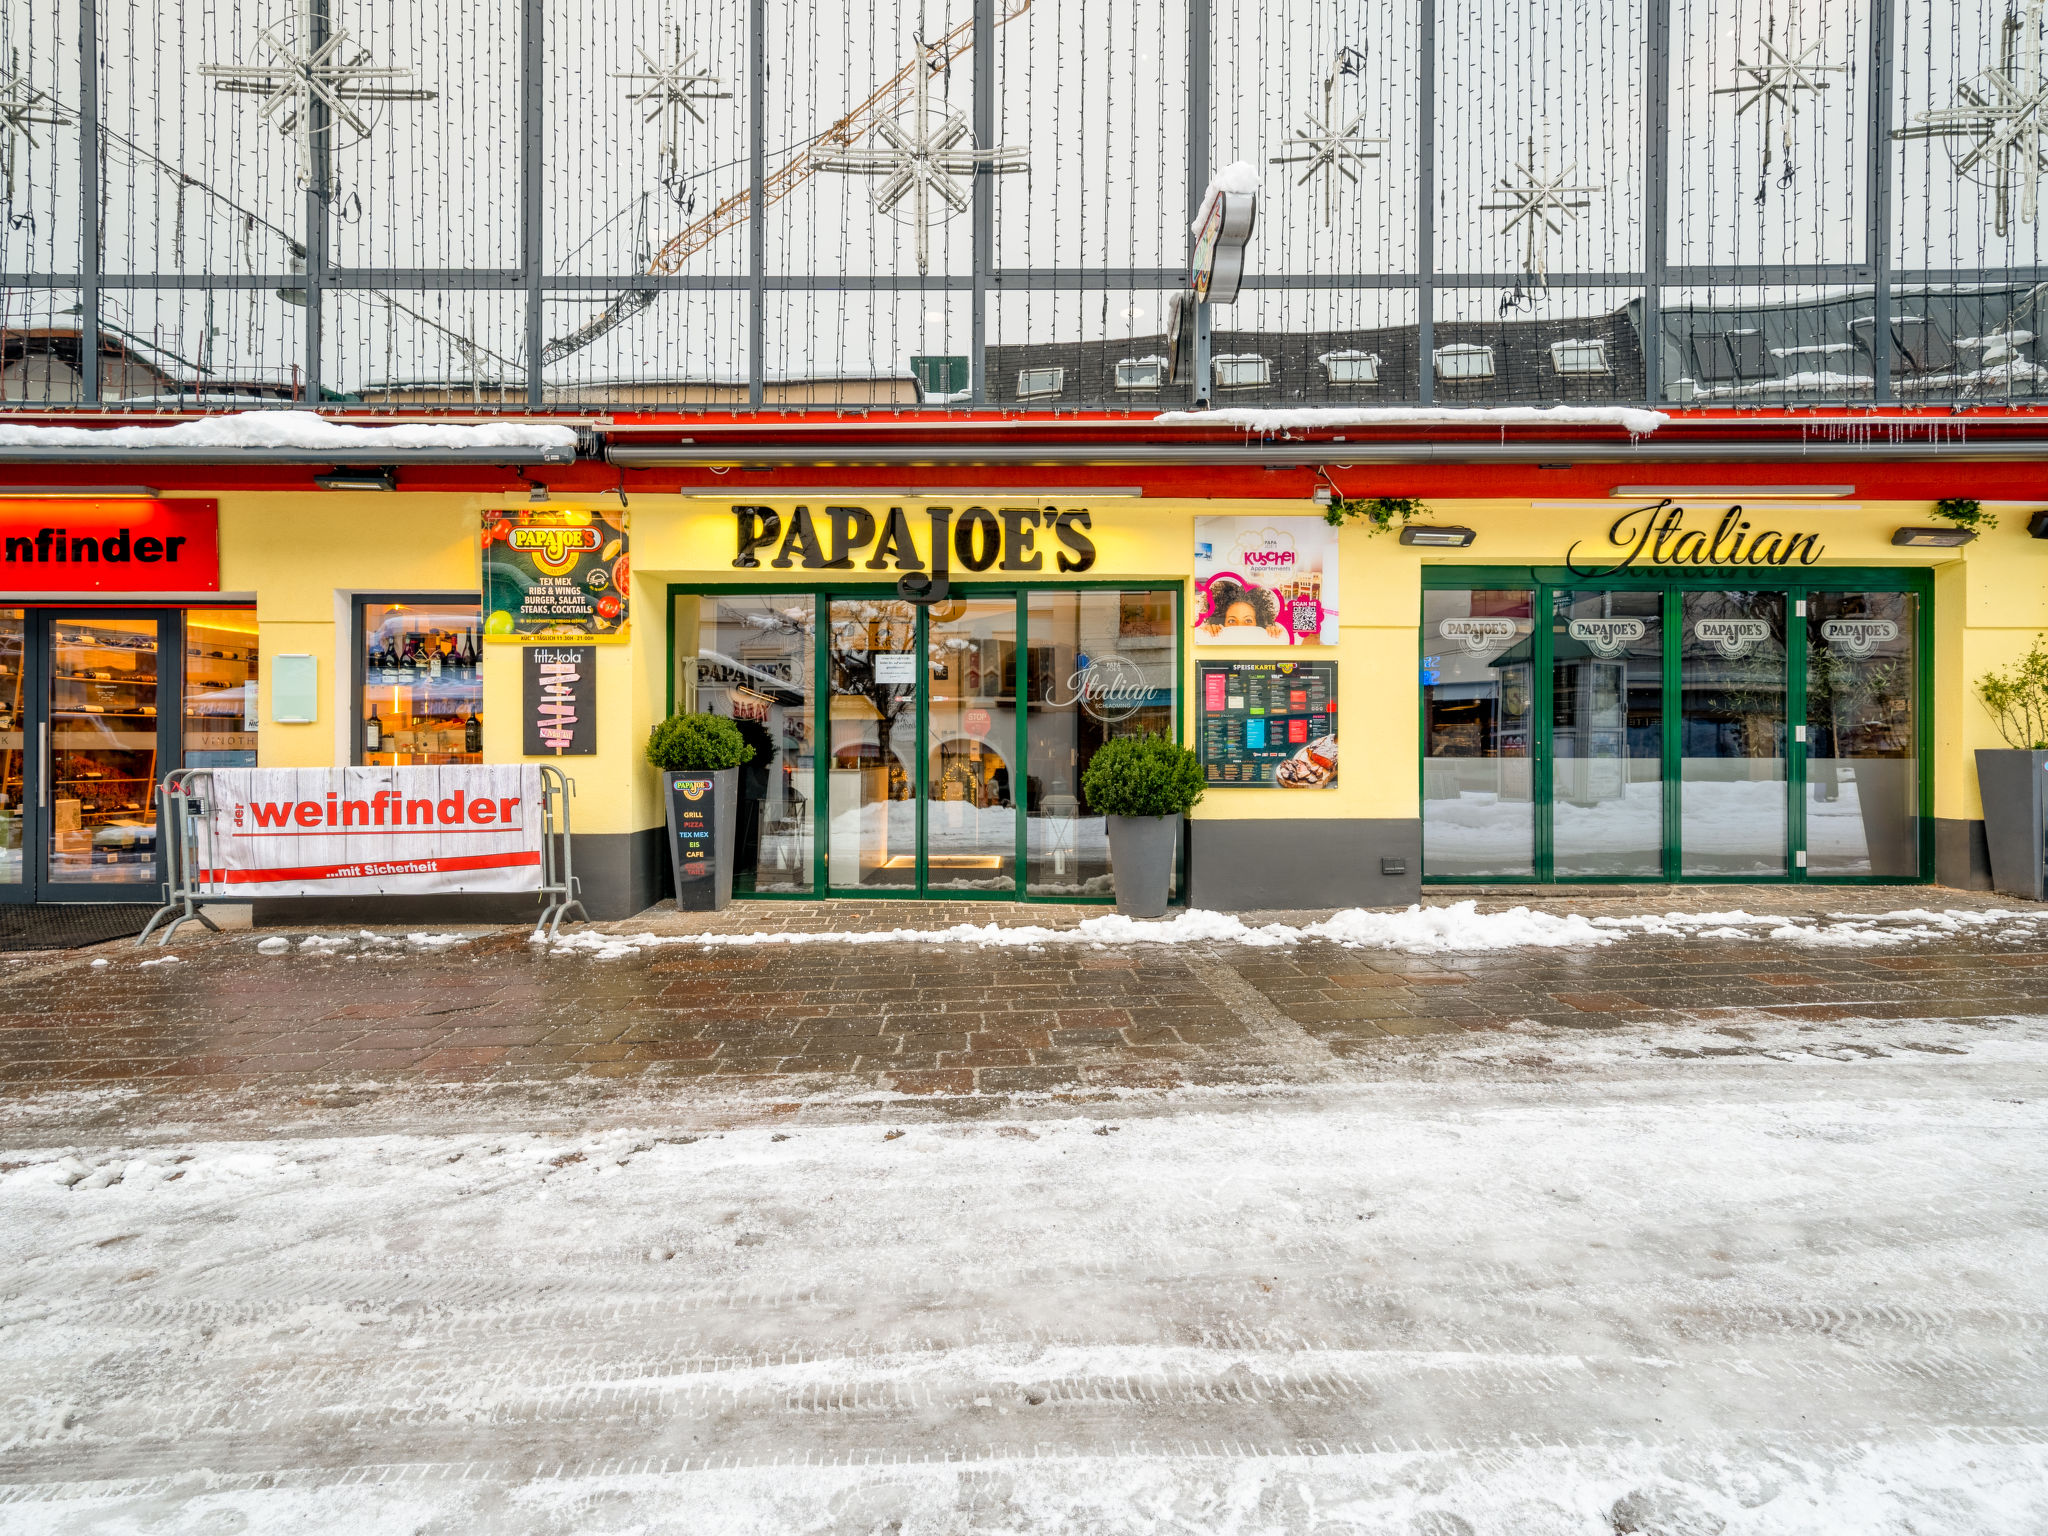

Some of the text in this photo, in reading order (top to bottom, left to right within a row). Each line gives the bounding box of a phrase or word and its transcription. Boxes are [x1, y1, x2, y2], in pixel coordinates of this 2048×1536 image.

[1566, 498, 1825, 578] Italian
[540, 577, 572, 586] TEX MEX
[529, 587, 581, 595] RIBS & WINGS
[524, 596, 585, 605] BURGER, SALATE
[520, 605, 592, 615] STEAKS, COCKTAILS
[534, 649, 581, 663] fritz-kola
[1046, 663, 1158, 707] Italian
[968, 713, 987, 721] STOP
[234, 802, 244, 828] der
[249, 789, 521, 828] weinfinder
[364, 861, 437, 876] Sicherheit
